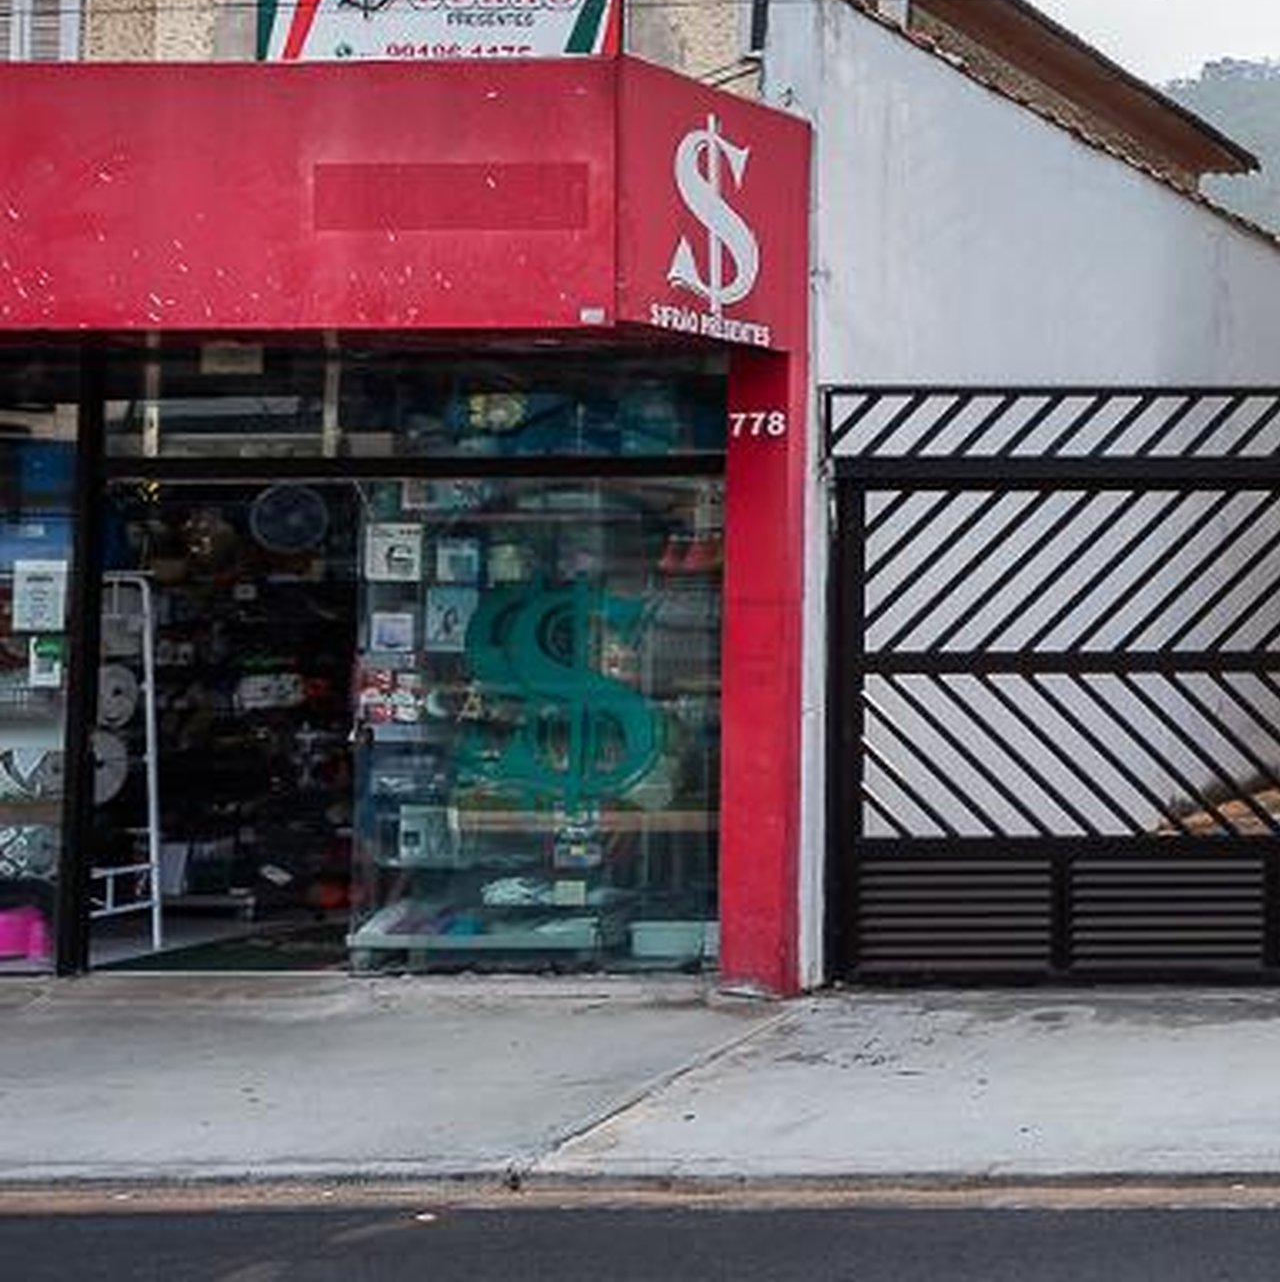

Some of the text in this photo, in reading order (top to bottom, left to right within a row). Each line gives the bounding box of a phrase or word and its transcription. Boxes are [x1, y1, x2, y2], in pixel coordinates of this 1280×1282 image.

[446, 12, 537, 28] PRESENTES
[700, 311, 771, 348] PRESENTES
[728, 411, 787, 437] 778
